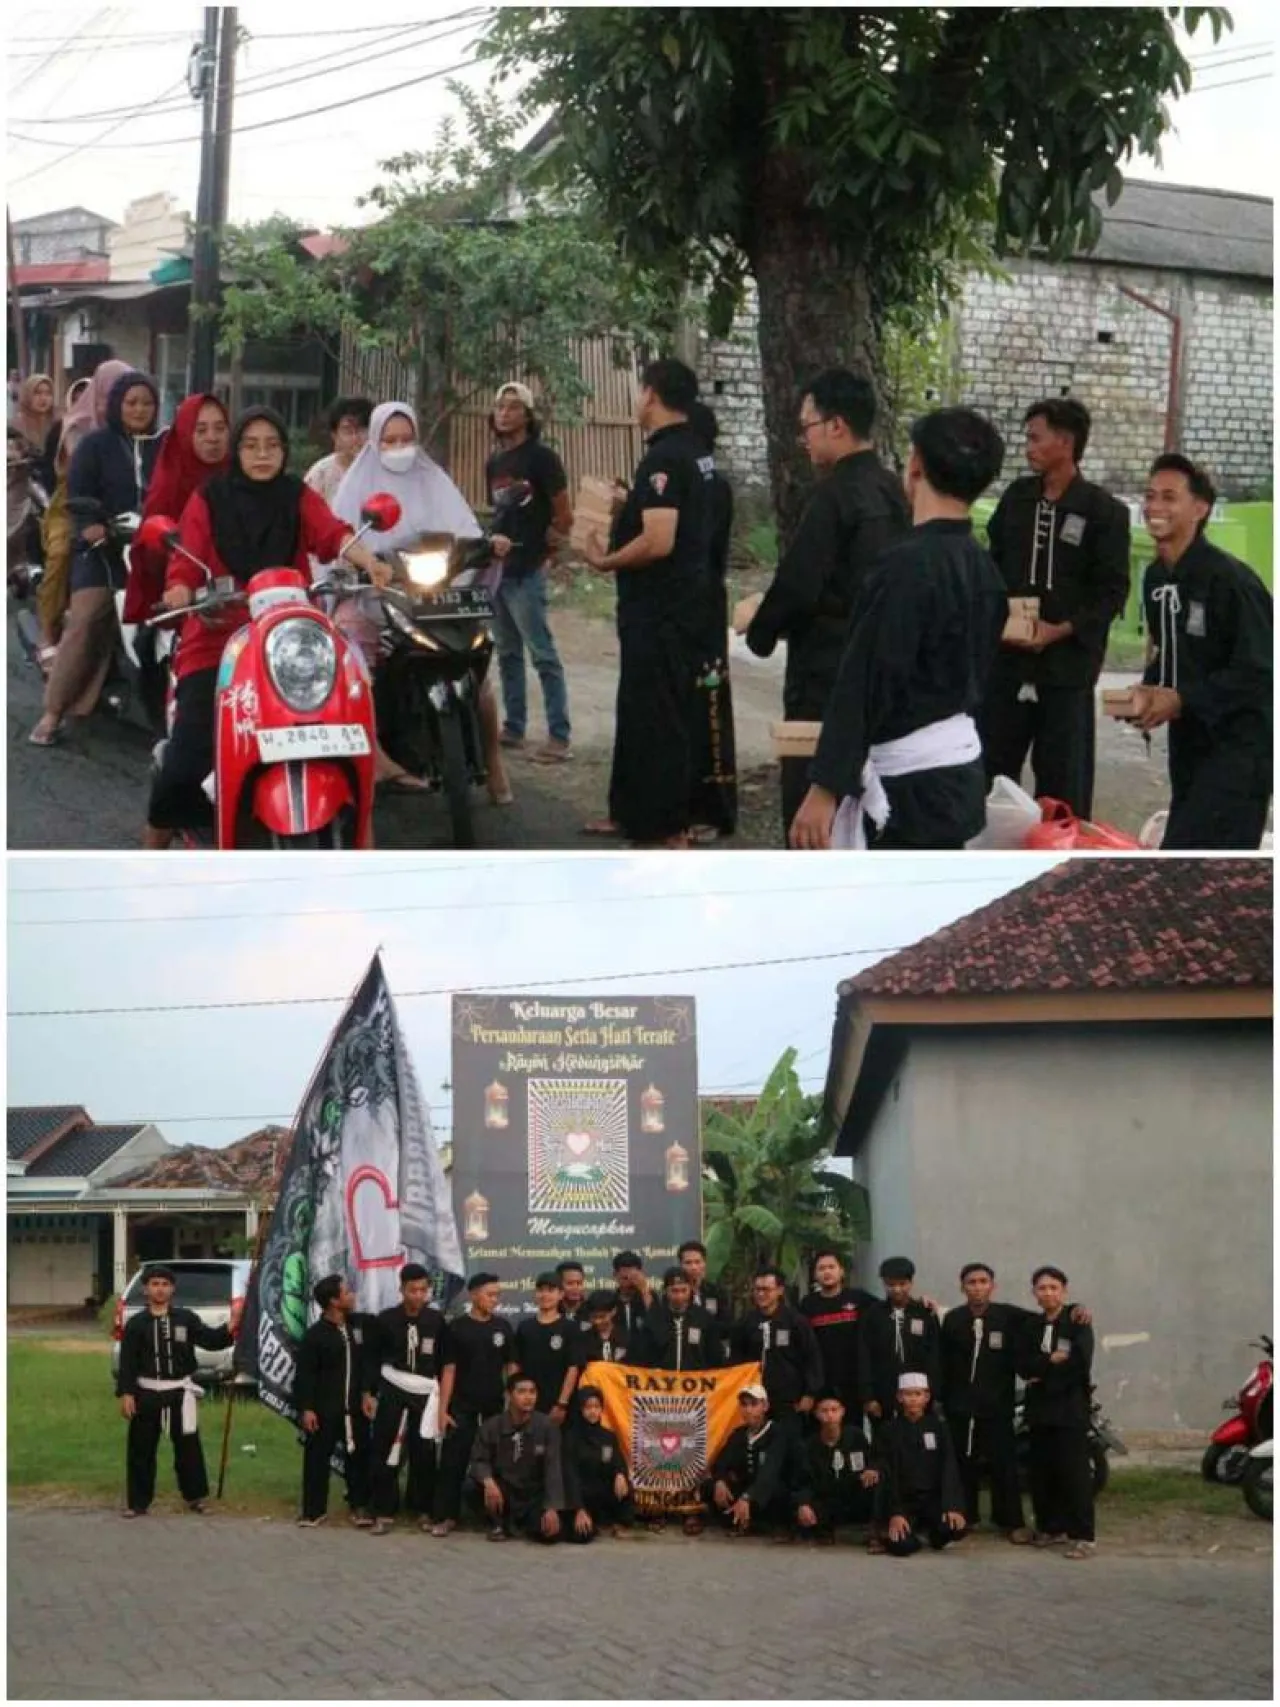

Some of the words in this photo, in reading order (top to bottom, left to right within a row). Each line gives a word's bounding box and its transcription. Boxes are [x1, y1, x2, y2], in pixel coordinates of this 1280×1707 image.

[510, 1001, 585, 1022] Keluarga
[589, 1001, 638, 1018] Besar
[632, 1024, 676, 1045] Terate
[499, 1051, 549, 1073] Rayon
[527, 1217, 636, 1241] Mengucapkan
[625, 1374, 717, 1392] RAYON
